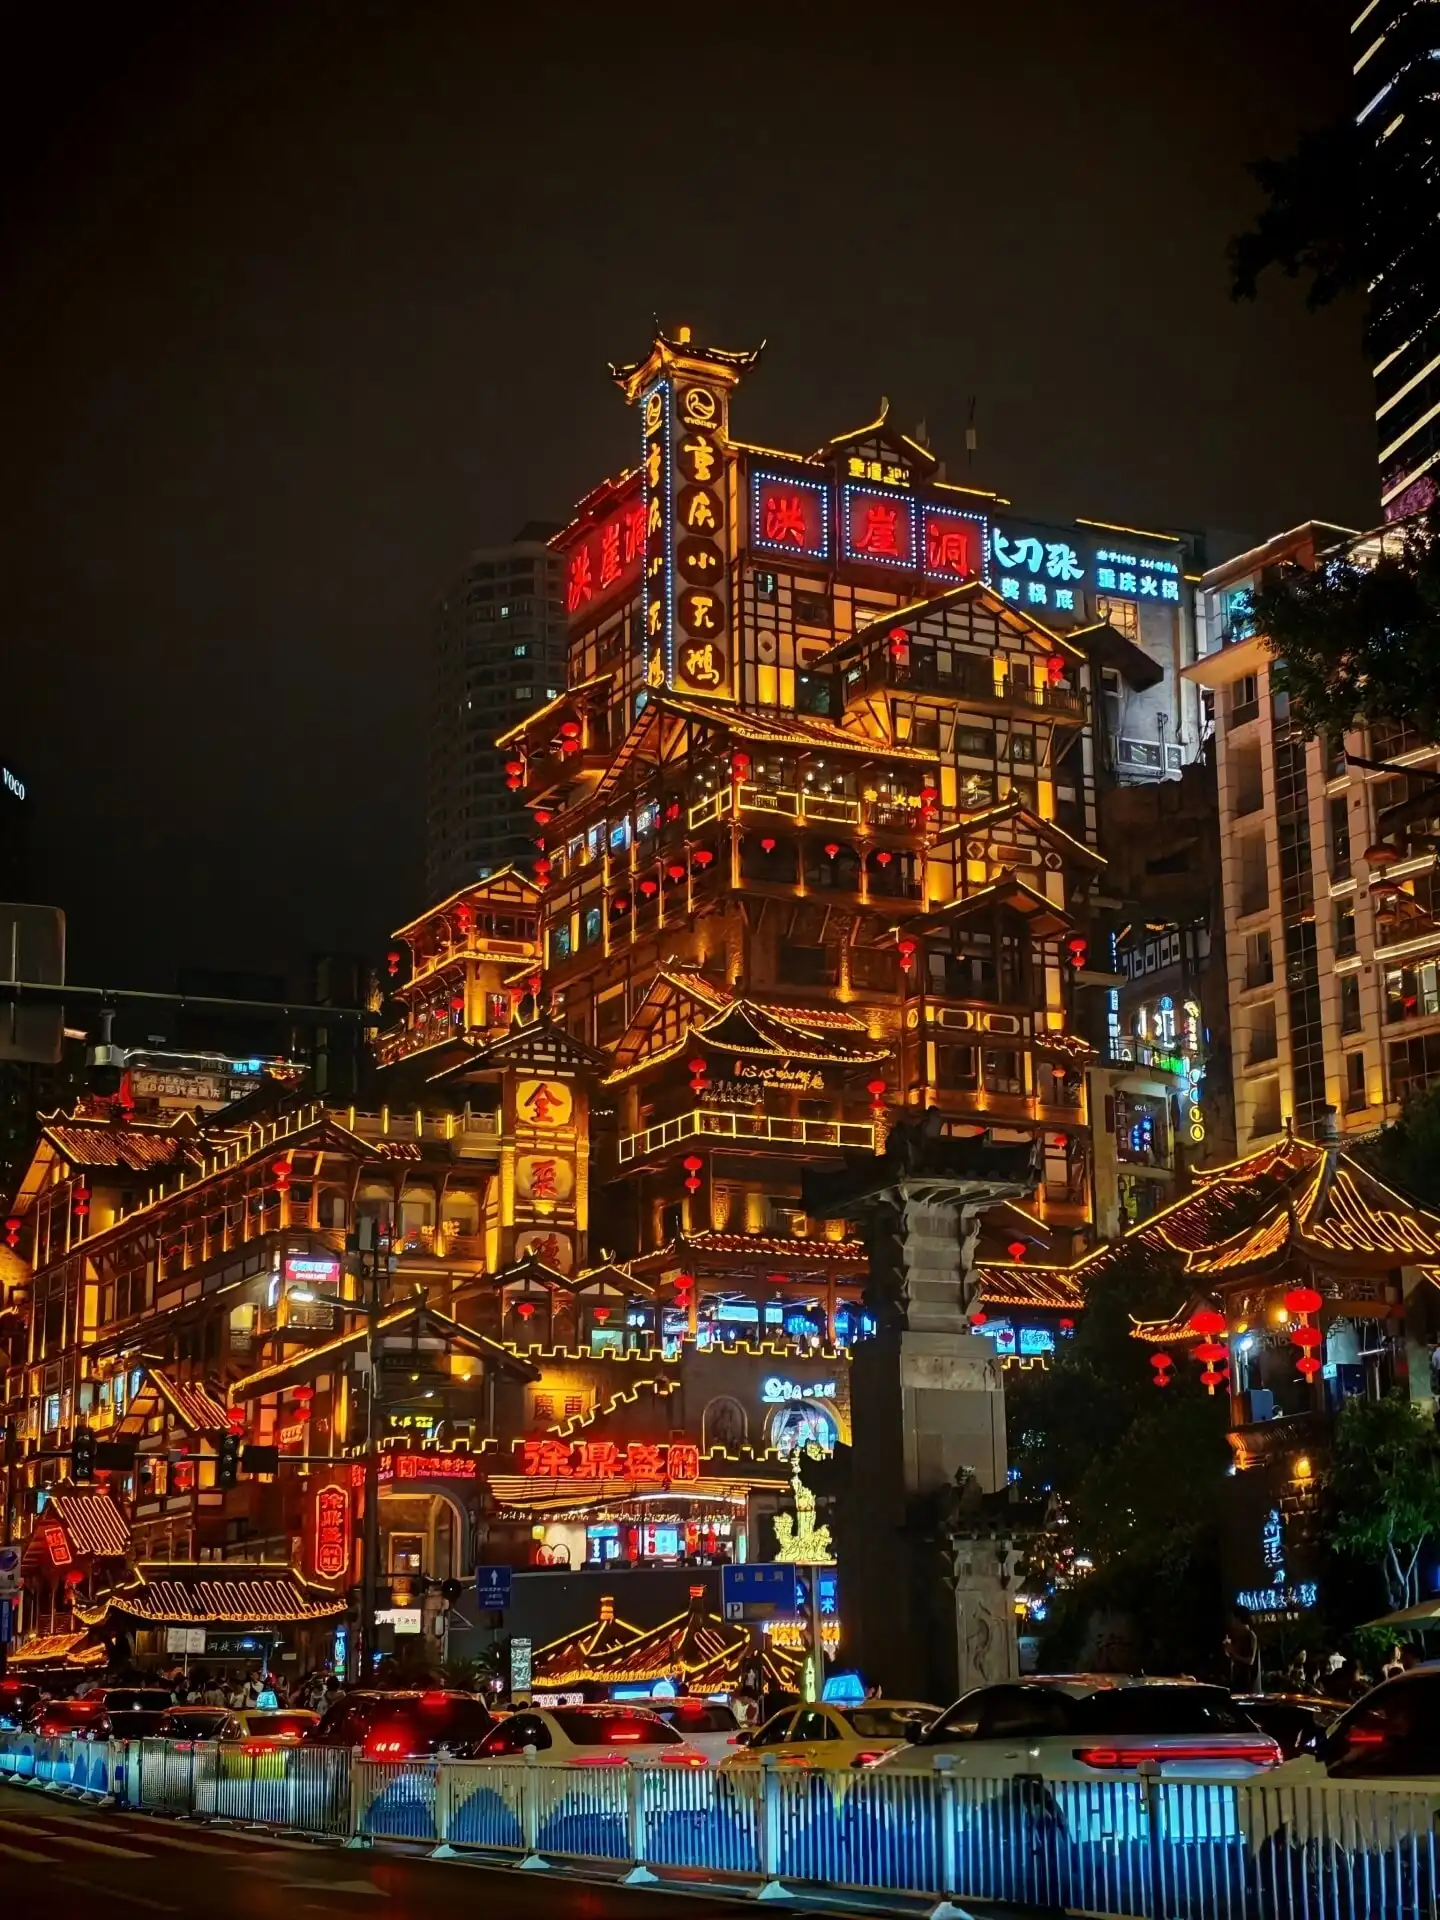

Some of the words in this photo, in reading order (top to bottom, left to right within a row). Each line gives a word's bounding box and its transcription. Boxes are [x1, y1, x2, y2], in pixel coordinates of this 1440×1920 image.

[767, 497, 968, 577] 洪崖洞
[1096, 567, 1179, 601] 重庆火锅
[523, 1440, 667, 1482] 徐鼎盛
